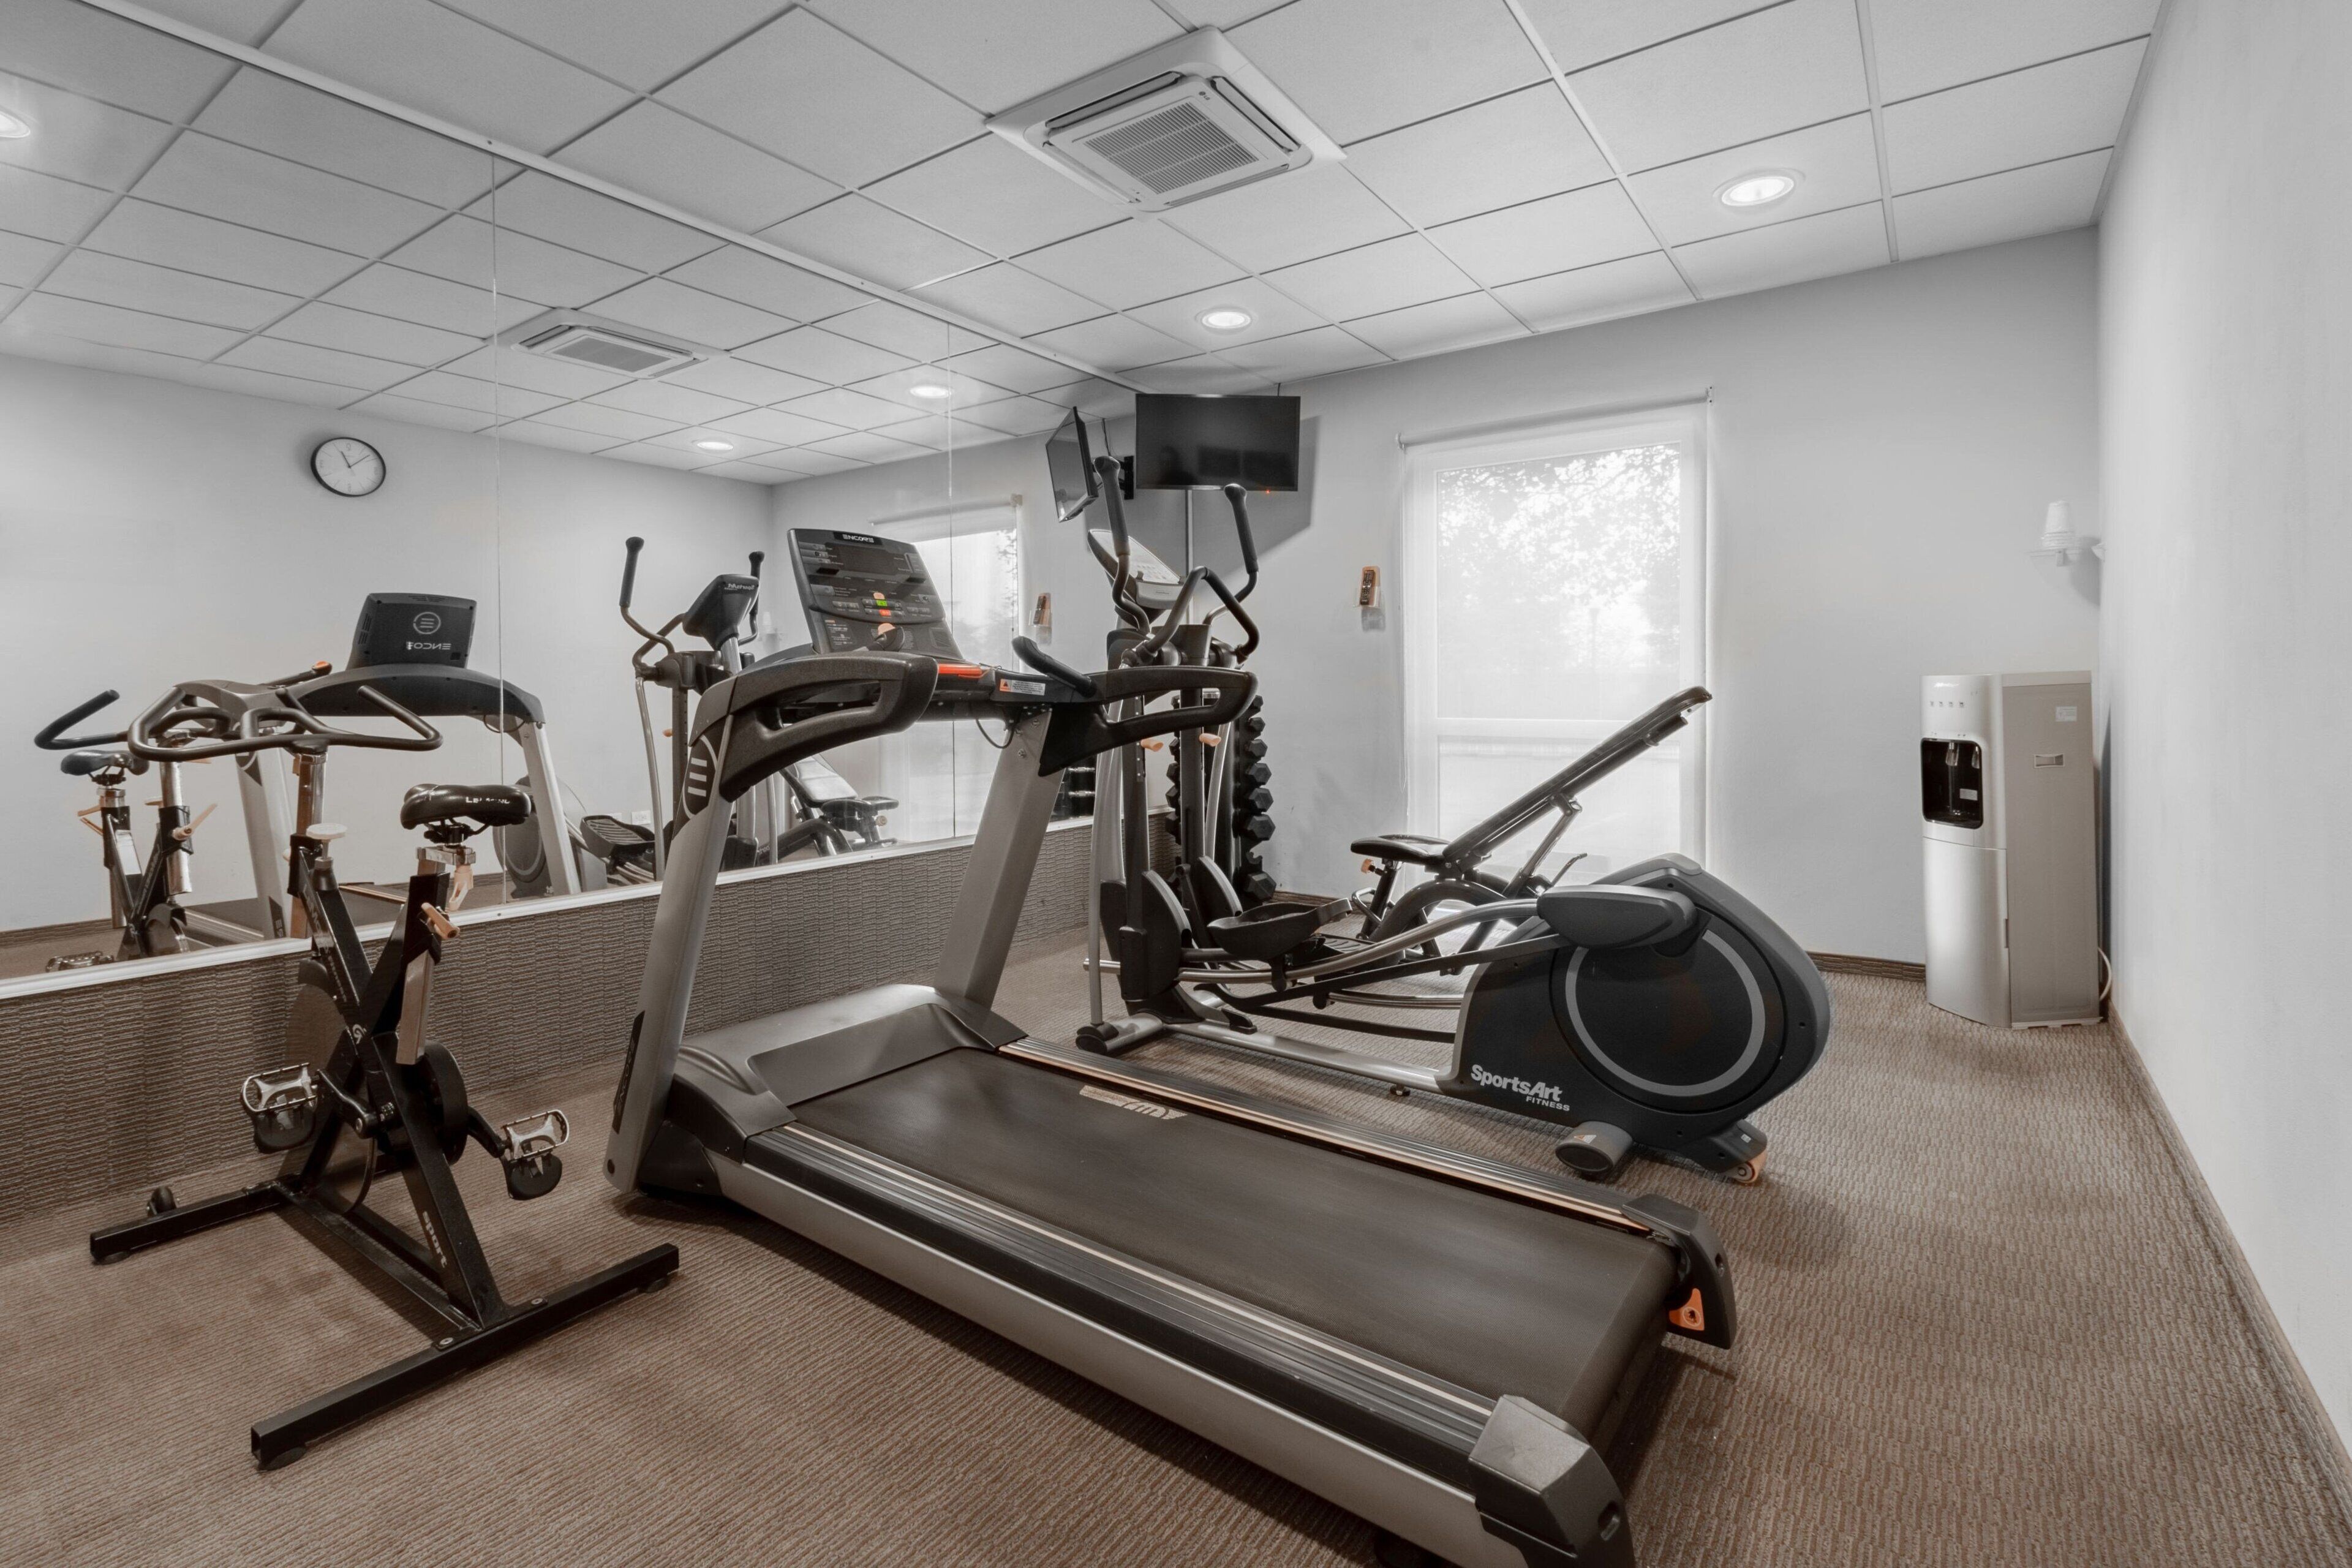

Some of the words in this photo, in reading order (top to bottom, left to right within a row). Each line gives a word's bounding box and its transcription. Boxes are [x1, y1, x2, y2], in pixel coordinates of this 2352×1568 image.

[842, 533, 875, 543] ENCORE
[1471, 1064, 1562, 1102] SportsArt
[1526, 1096, 1570, 1112] FITNESS
[422, 1211, 447, 1268] sport
